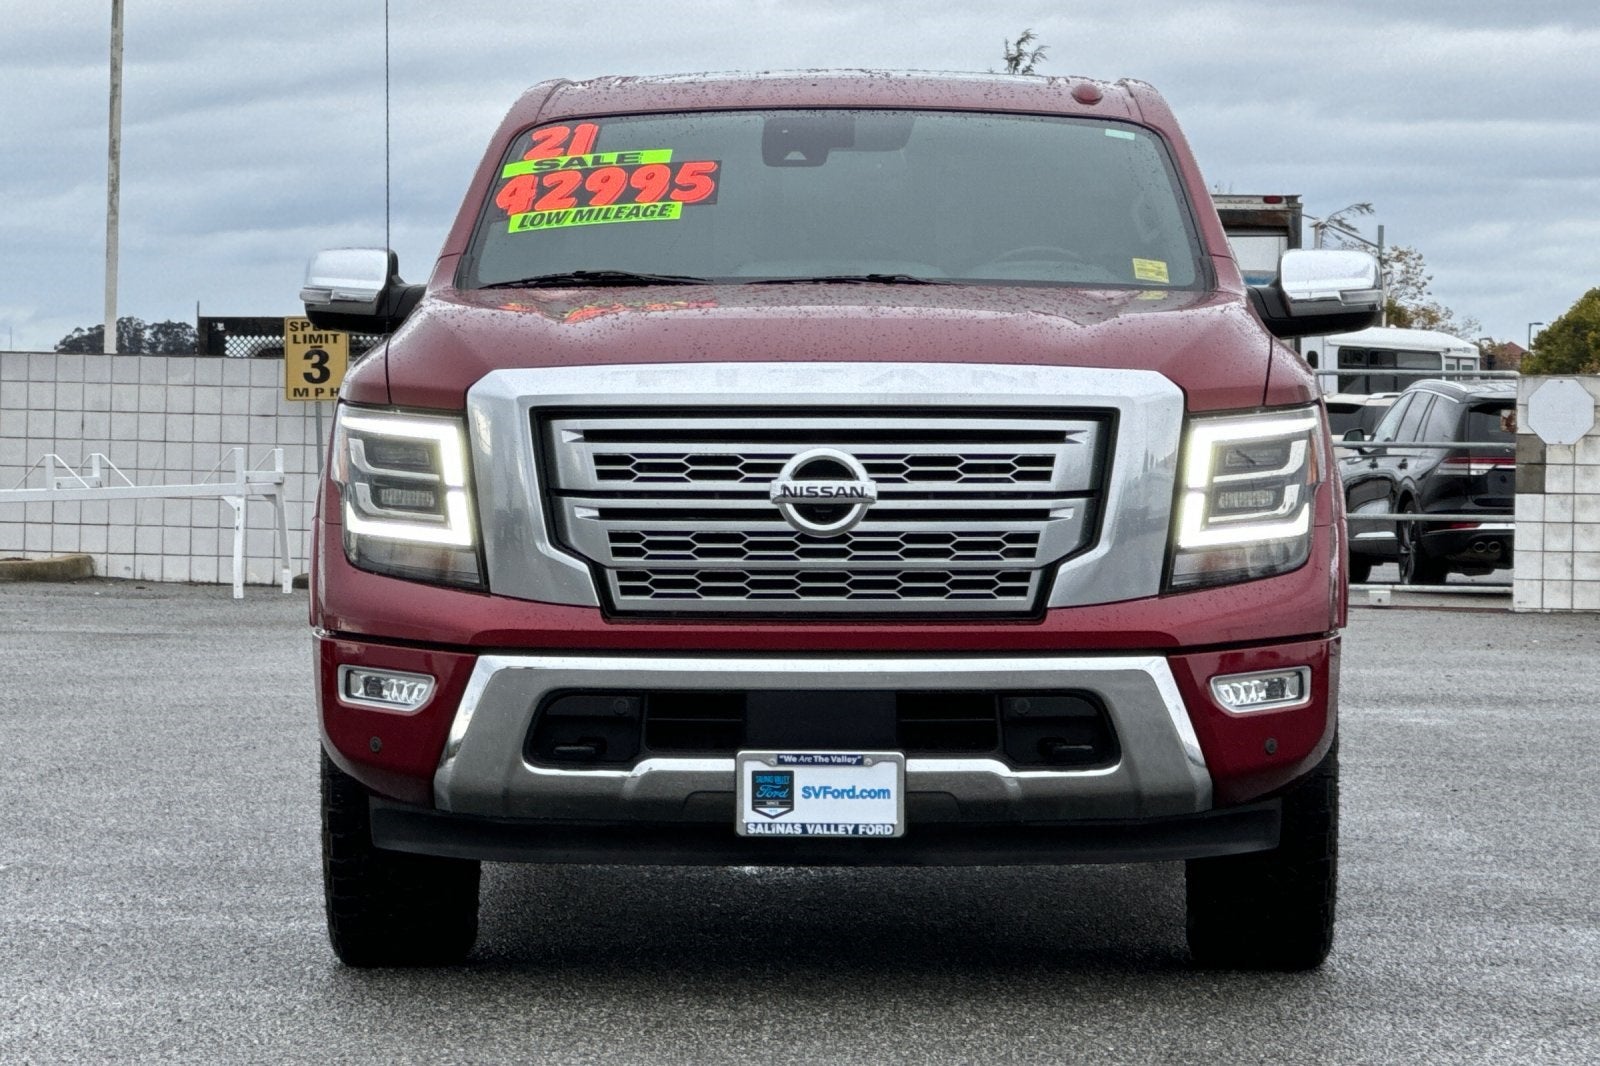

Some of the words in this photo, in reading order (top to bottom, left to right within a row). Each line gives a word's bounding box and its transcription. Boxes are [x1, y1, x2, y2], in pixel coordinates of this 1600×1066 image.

[523, 123, 599, 161] 21
[532, 152, 643, 171] SALE
[495, 161, 718, 215] 42995
[518, 211, 572, 229] LOW
[571, 202, 676, 223] MILEAGE
[292, 334, 340, 344] LIMIT
[303, 349, 331, 384] 3
[782, 486, 865, 498] NISSAN
[813, 755, 830, 763] The
[756, 785, 789, 799] Ford
[801, 785, 891, 799] SVFord.com
[747, 823, 802, 835] SALINAS
[806, 823, 854, 835] VALLEY
[859, 823, 893, 835] FORD
